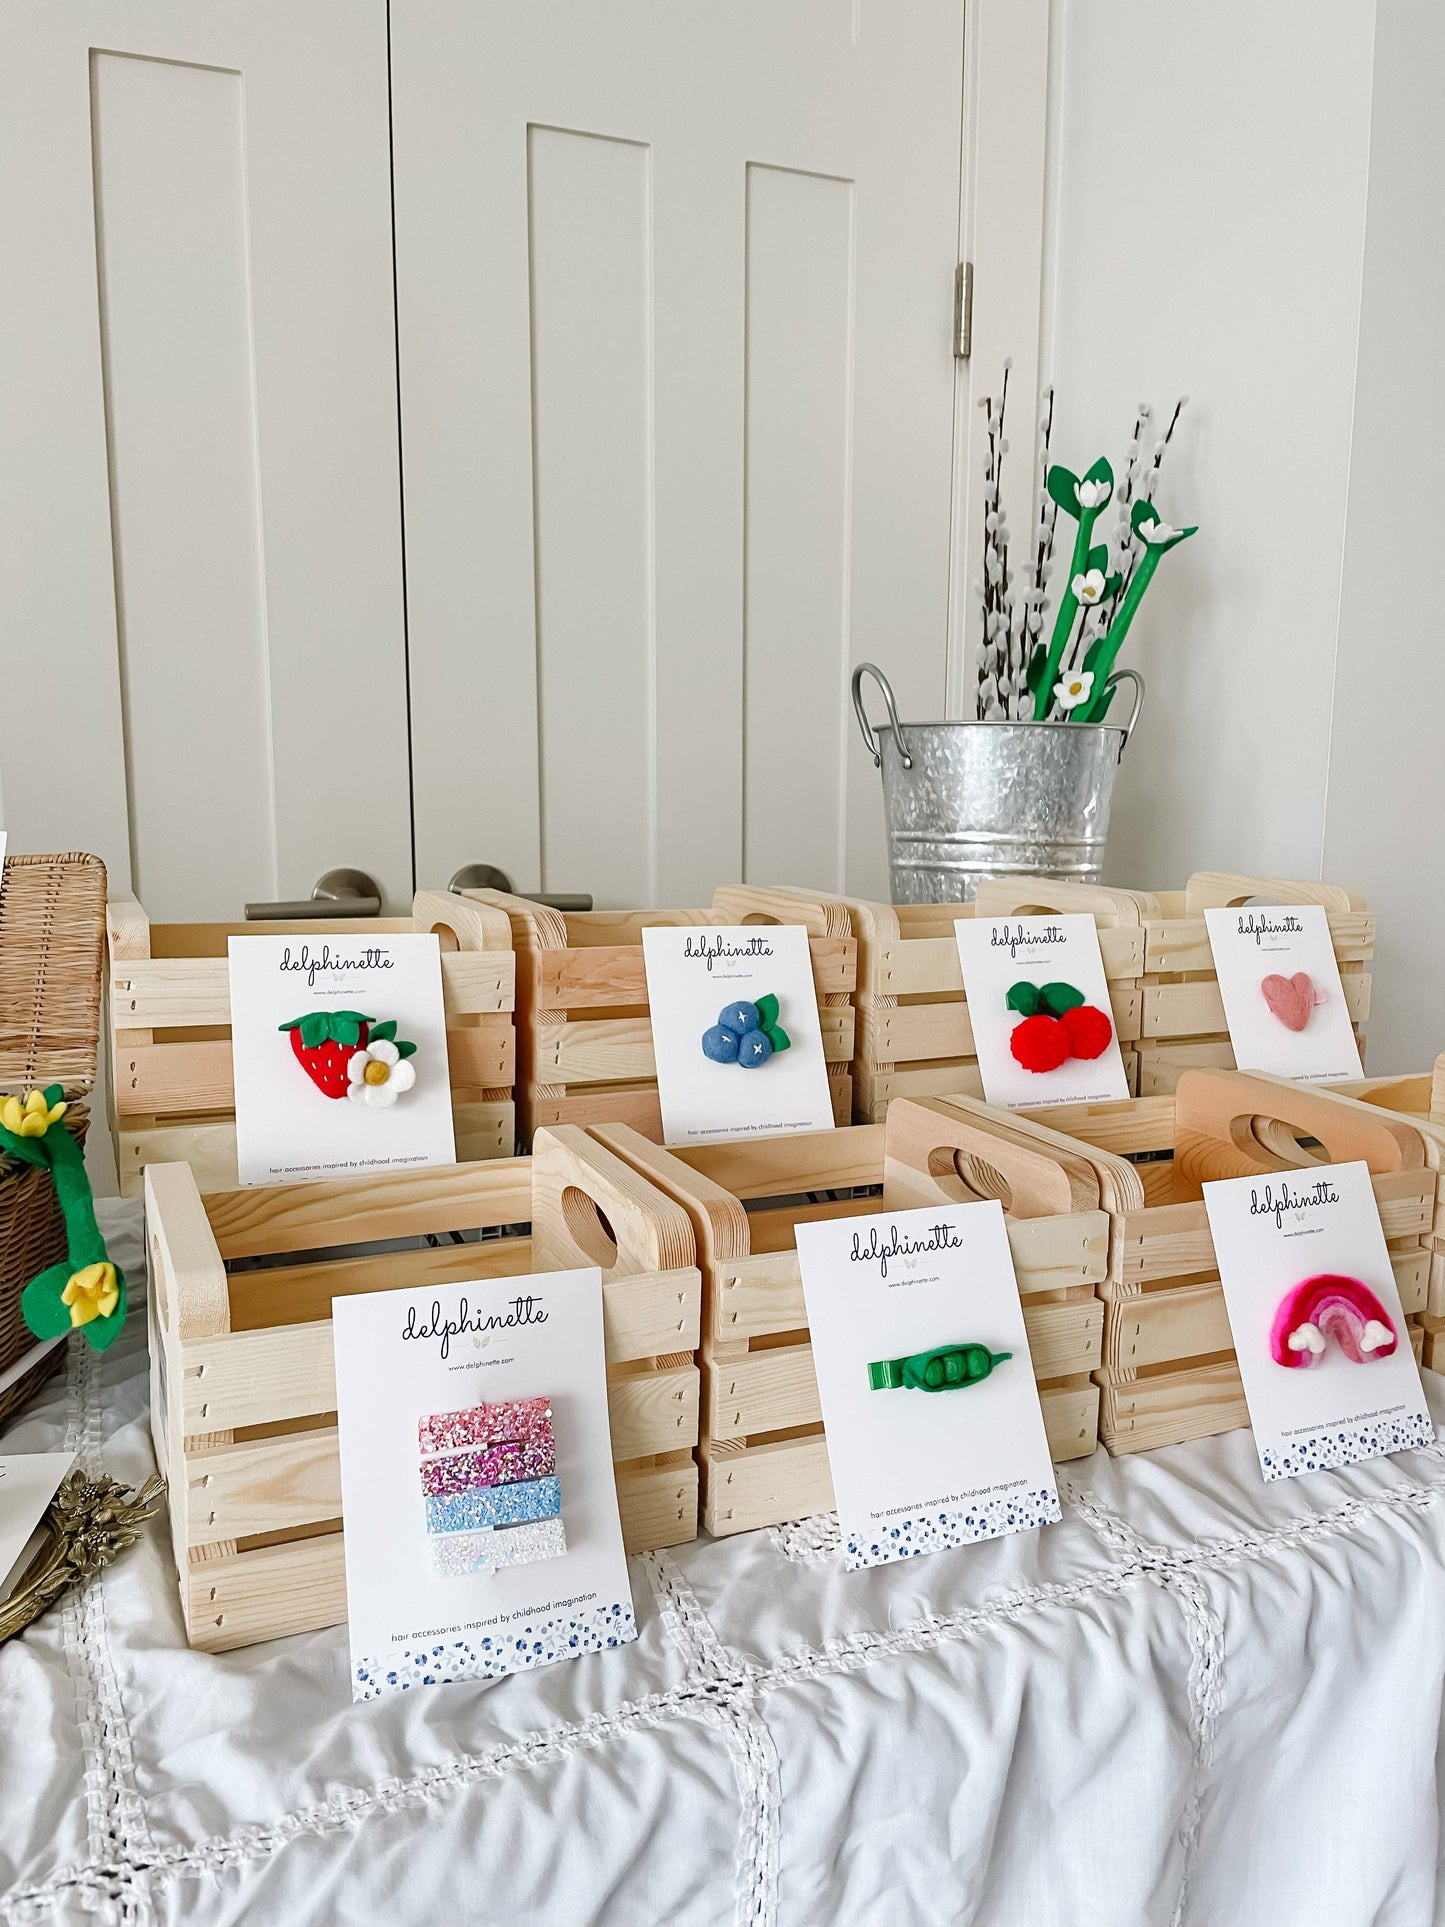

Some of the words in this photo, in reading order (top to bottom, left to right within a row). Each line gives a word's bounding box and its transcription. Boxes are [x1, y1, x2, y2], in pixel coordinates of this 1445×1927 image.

[991, 925, 1066, 958] delphinette
[1238, 914, 1303, 945] delphinette
[280, 945, 394, 986] delphinette
[684, 935, 773, 971] delphinette
[285, 1164, 320, 1173] accessories
[323, 1162, 348, 1170] inspired
[359, 1158, 389, 1166] childhood
[392, 1155, 428, 1164] imagination
[1251, 1182, 1339, 1229] delphinette
[851, 1224, 963, 1278] delphinette
[402, 1296, 549, 1359] delphinette
[448, 1358, 514, 1371] www.delphinette.com
[1354, 1410, 1378, 1421] childhood
[871, 1511, 885, 1519] hair
[886, 1502, 922, 1516] accessories
[924, 1495, 949, 1507] inspired
[951, 1494, 959, 1502] by
[960, 1486, 991, 1499] childhood
[992, 1479, 1028, 1493] imagination
[391, 1632, 409, 1642] hair
[412, 1624, 462, 1639] accessories
[464, 1616, 498, 1631] inspired
[500, 1612, 510, 1623] by
[512, 1602, 550, 1620] childhood
[553, 1592, 597, 1609] imagination
